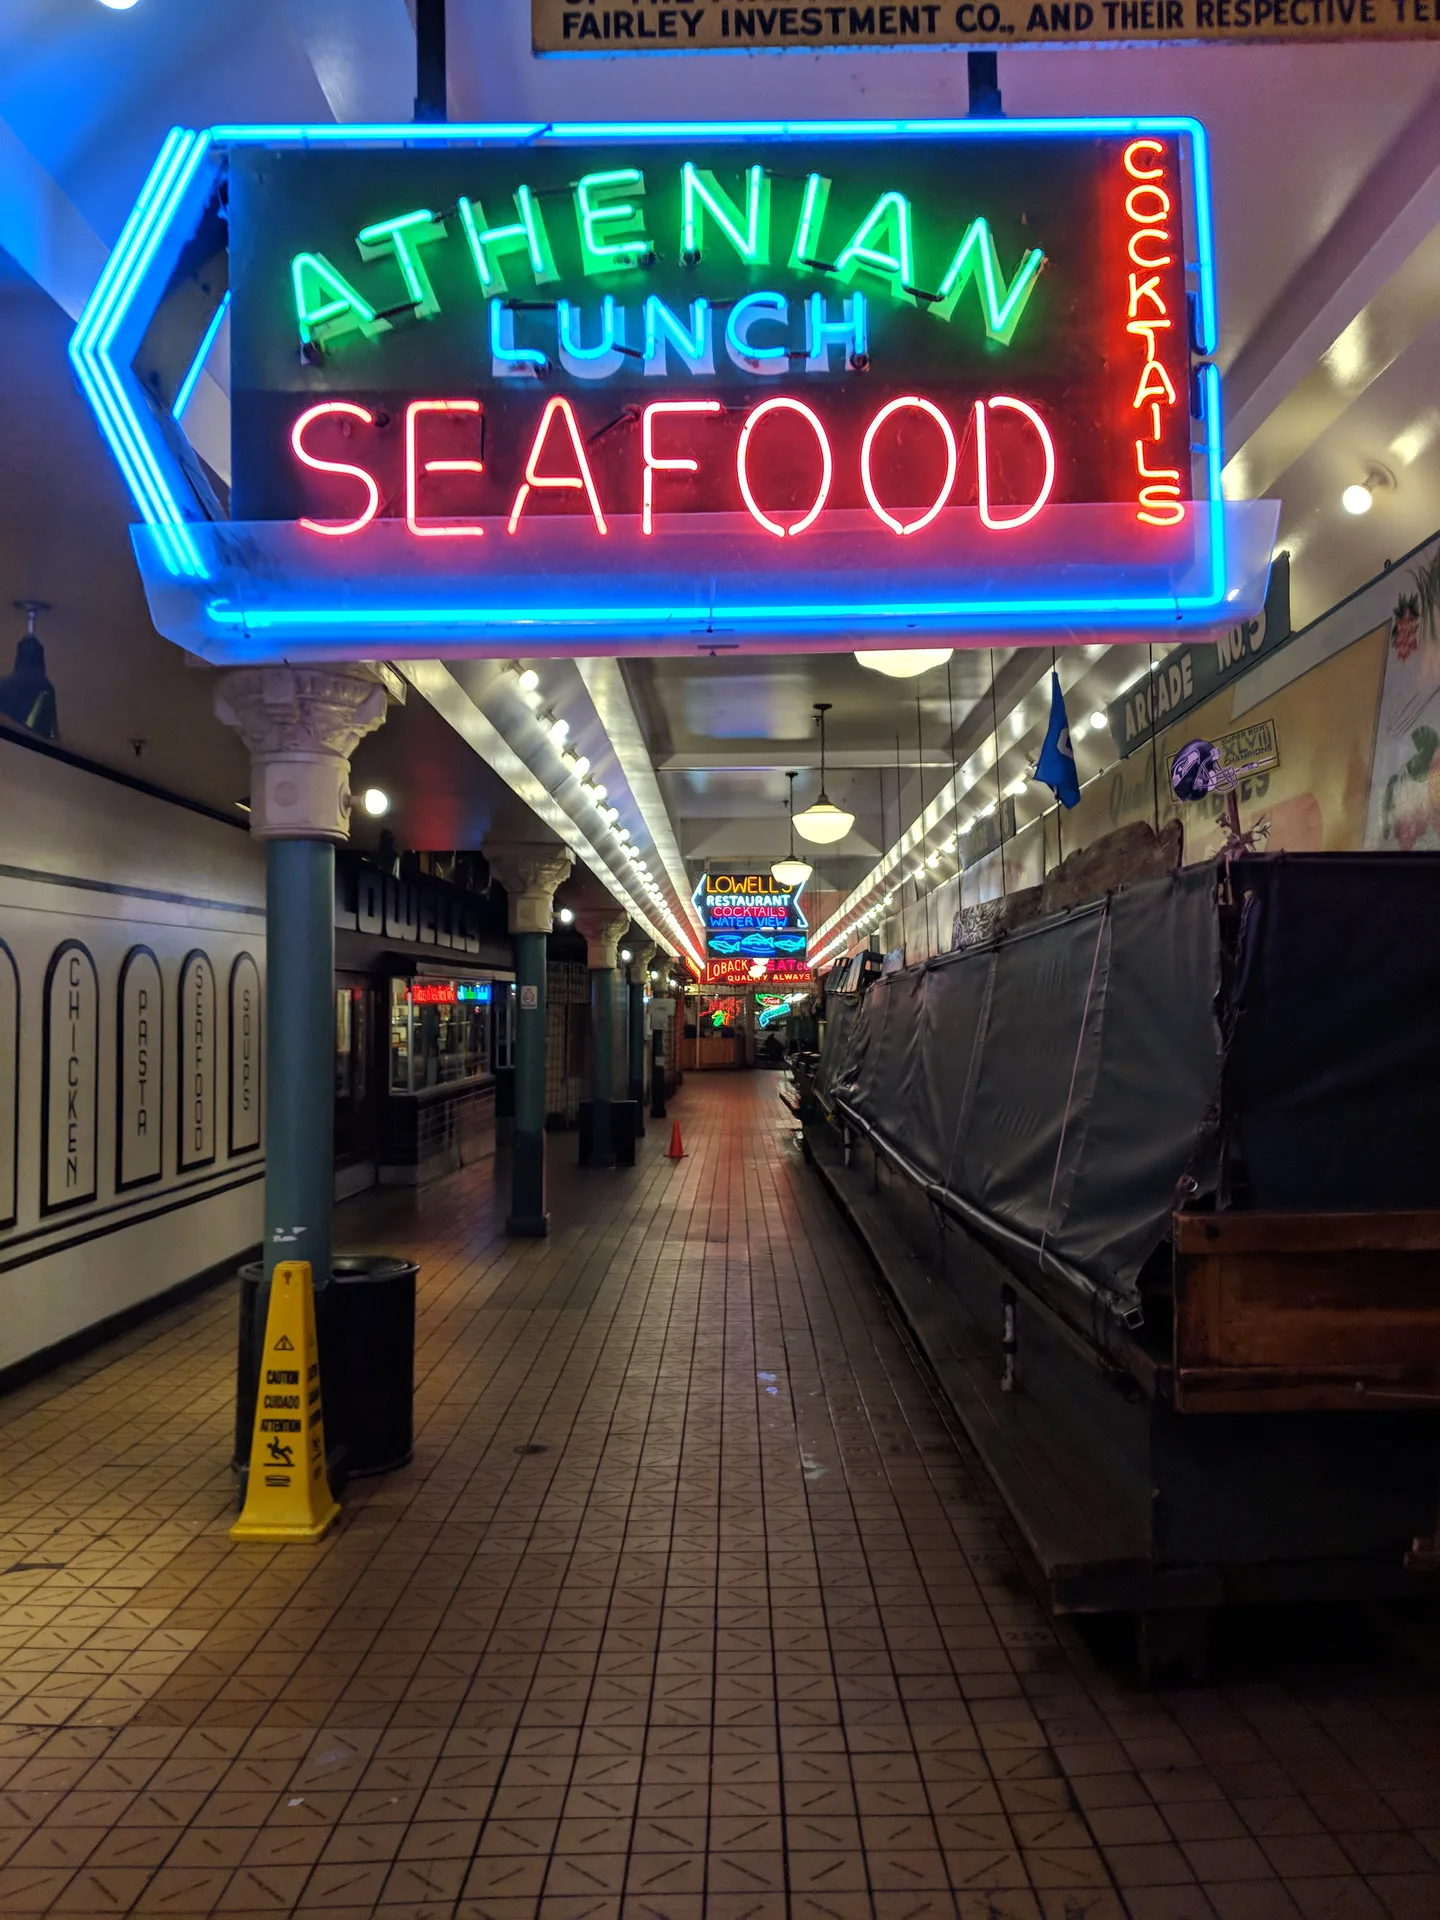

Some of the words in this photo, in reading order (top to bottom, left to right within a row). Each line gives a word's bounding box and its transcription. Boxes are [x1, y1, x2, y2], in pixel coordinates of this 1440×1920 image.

[562, 9, 706, 39] FAIRLEY
[720, 5, 942, 38] INVESTMENT
[1026, 2, 1095, 32] AND
[1103, 1, 1185, 30] THEIR
[1198, 0, 1377, 28] RESPECTIVE
[1393, 0, 1440, 22] TE
[290, 160, 1048, 350] ATHENIAN
[488, 290, 870, 379] LUNCH
[1122, 140, 1186, 526] COCKTAILS
[290, 396, 1056, 538] SEAFOOD
[1125, 652, 1194, 742] ARCADE
[1221, 732, 1247, 744] SUPER
[1247, 723, 1270, 735] BOWL
[1223, 729, 1272, 758] XLVIII
[1223, 744, 1273, 766] CHAMPIONS
[706, 895, 791, 906] RESTAURANT
[713, 906, 786, 917] COCKTAILS
[709, 916, 754, 927] WATER
[755, 916, 788, 927] VIEW
[706, 959, 749, 981] LOBACK
[751, 960, 796, 971] EAT
[772, 973, 811, 981] ALWAYS
[137, 989, 148, 1137] PASTA
[194, 964, 204, 1152] SEAFOOD
[66, 956, 80, 1188] CHICKEN
[266, 1370, 299, 1385] CAUTION
[264, 1394, 300, 1409] CUIDADO
[260, 1419, 302, 1433] ATTENTION
